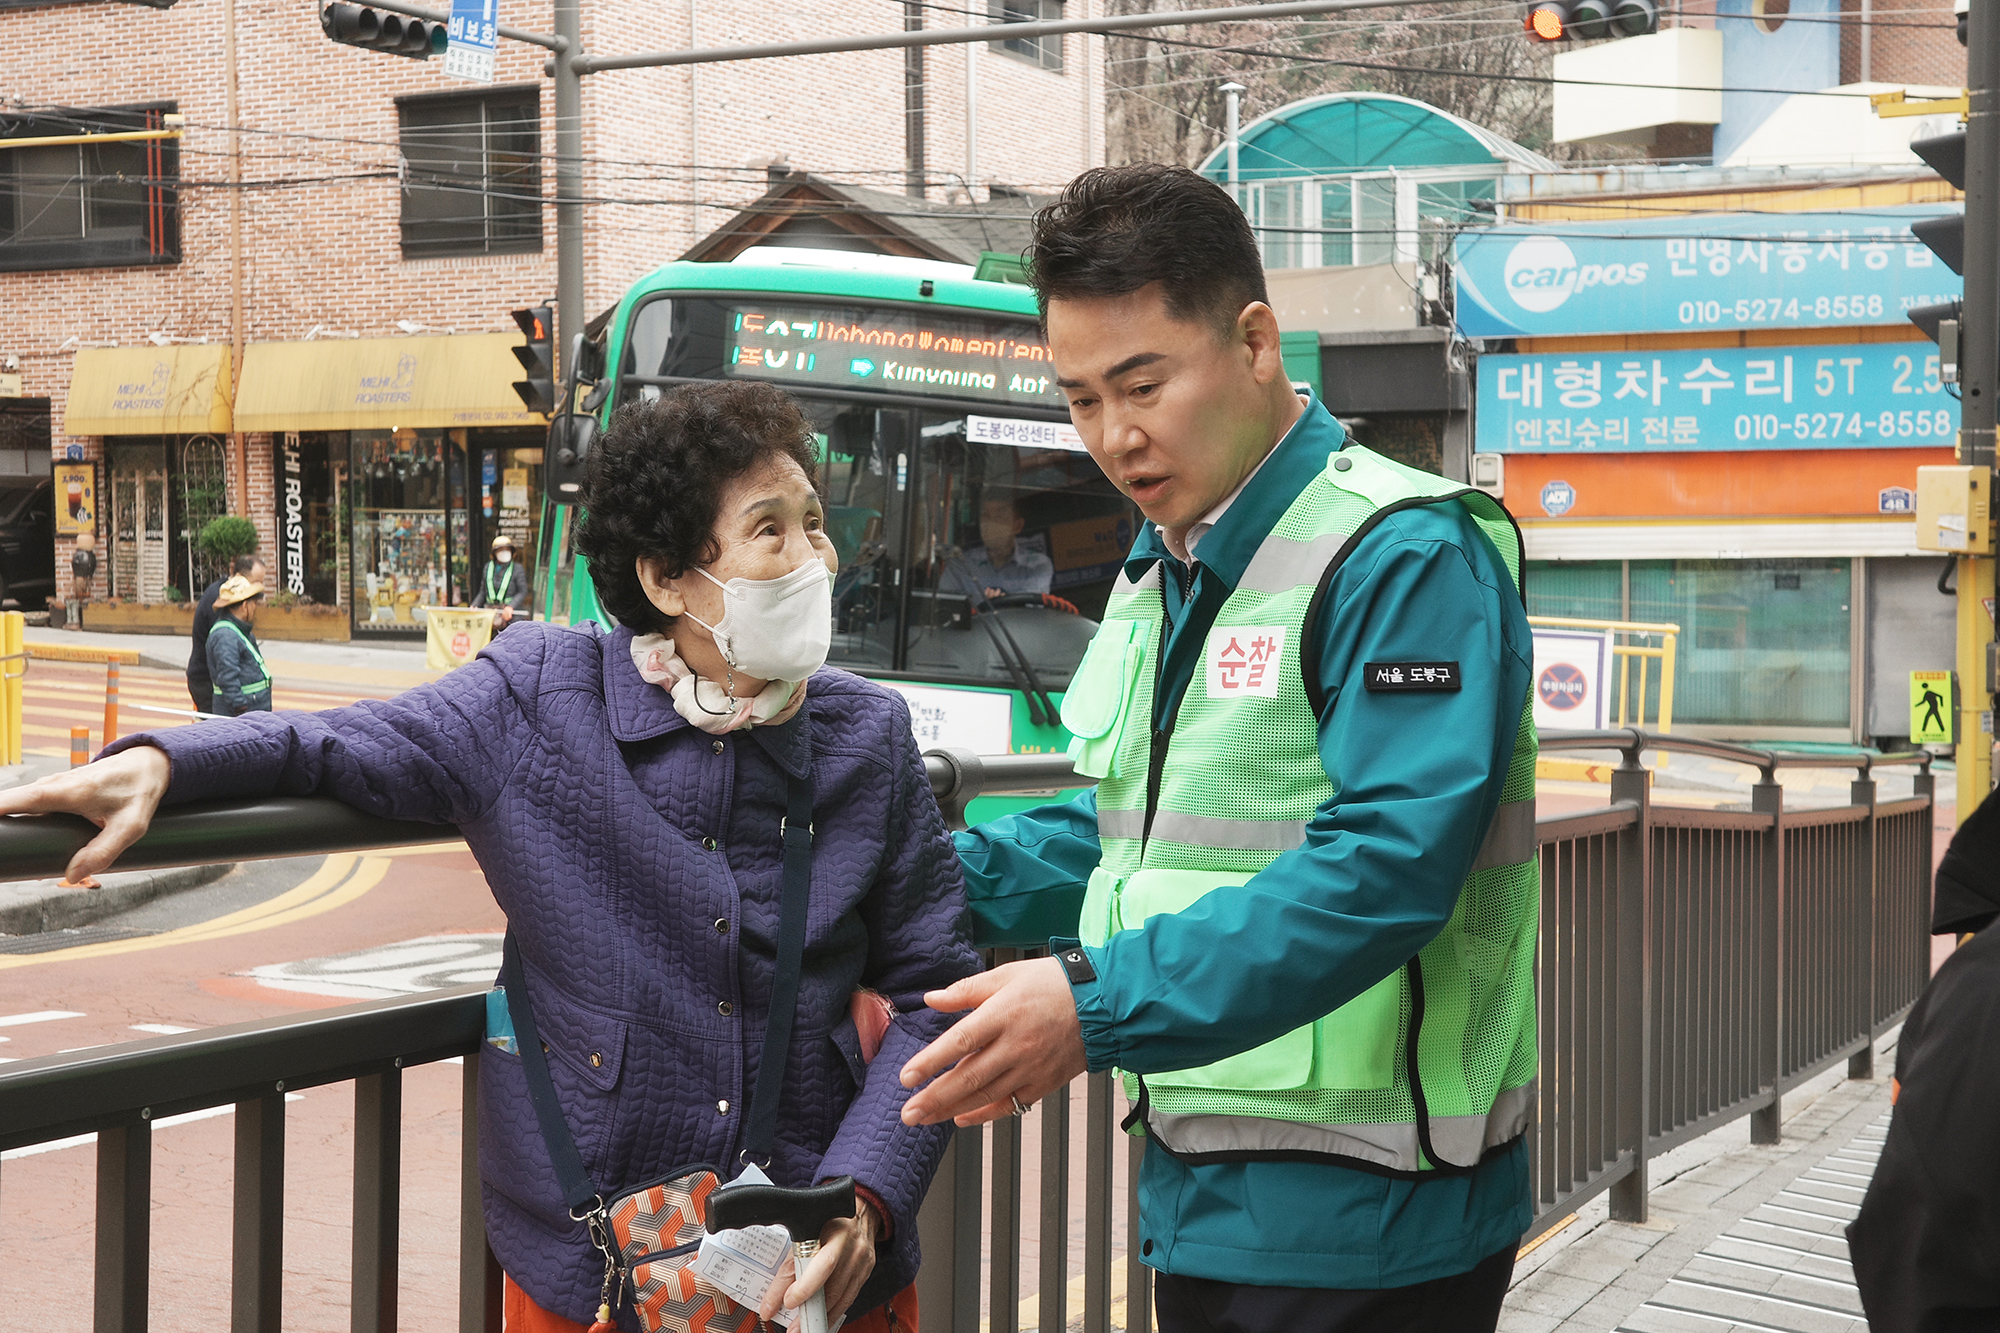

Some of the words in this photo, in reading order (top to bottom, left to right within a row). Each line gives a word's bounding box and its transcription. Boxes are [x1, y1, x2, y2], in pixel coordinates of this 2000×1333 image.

[451, 16, 494, 46] 비보호
[1511, 262, 1650, 294] carpos
[1679, 294, 1884, 324] 010-5274-8558
[1815, 357, 1863, 397] 5T
[112, 398, 164, 409] ROASTERS
[355, 391, 411, 404] ROASTERS
[976, 422, 1056, 444] 도봉여성센터
[1515, 416, 1629, 447] 엔진수리
[1641, 416, 1700, 444] 전문
[1735, 409, 1951, 440] 010-5274-8558
[1546, 491, 1569, 504] ADT
[285, 478, 304, 595] ROASTERS
[1218, 636, 1277, 689] 순찰
[1376, 667, 1405, 683] 서울
[1410, 667, 1451, 683] 도봉구
